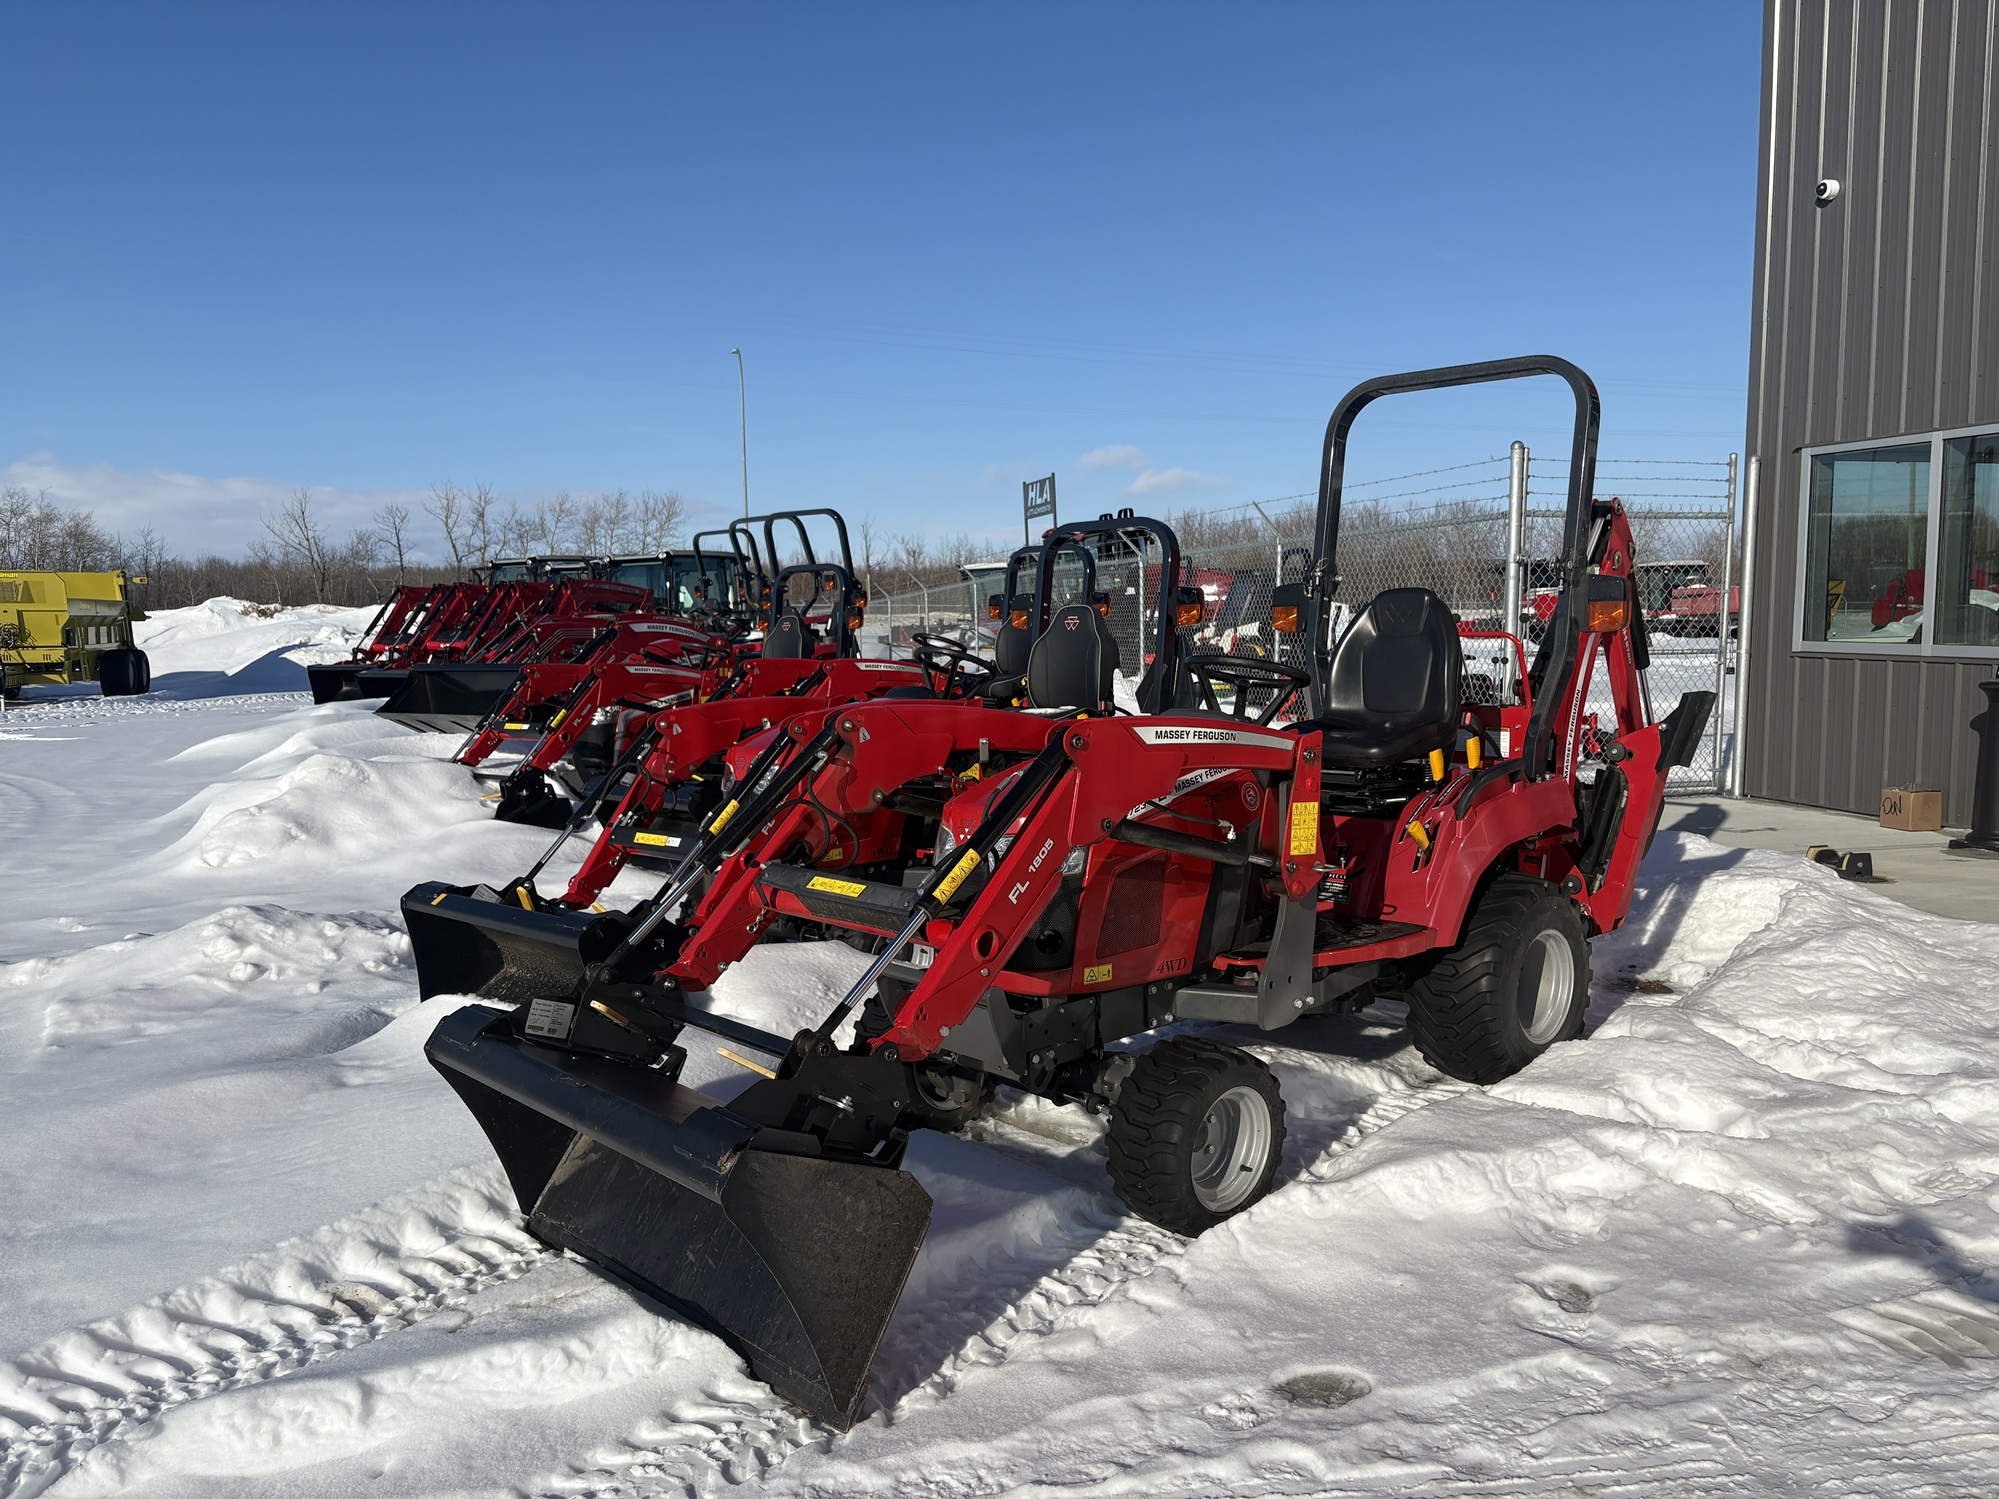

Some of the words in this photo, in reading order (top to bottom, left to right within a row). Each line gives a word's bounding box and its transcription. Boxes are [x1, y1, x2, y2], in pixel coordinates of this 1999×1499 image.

[1028, 480, 1050, 507] HLA
[669, 626, 695, 637] FERGUSON
[1155, 730, 1191, 740] MASSEY
[1192, 730, 1237, 741] FERGUSON
[1564, 742, 1572, 779] MASSEY
[1569, 689, 1581, 738] FERGUSON
[1174, 772, 1204, 793] MASSEY
[761, 819, 776, 836] FL
[1008, 880, 1030, 905] FL
[1028, 837, 1054, 873] 1805
[1156, 957, 1188, 975] 4WD
